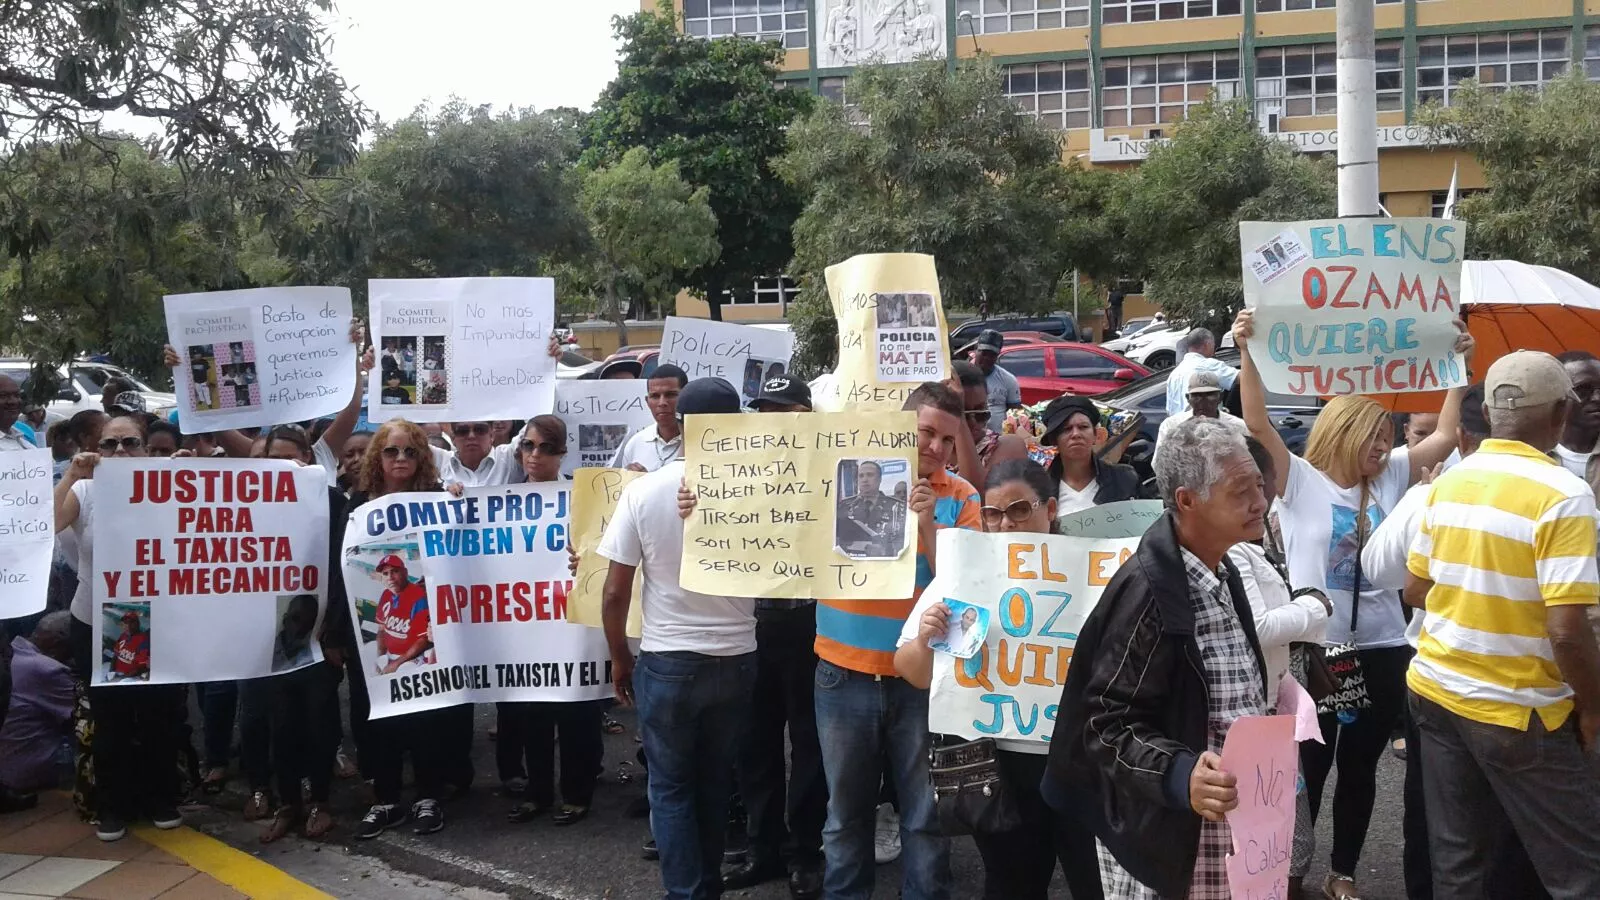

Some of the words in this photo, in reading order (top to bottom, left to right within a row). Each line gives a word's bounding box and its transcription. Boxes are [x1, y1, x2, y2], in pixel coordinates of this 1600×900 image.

[1310, 223, 1365, 259] EL
[1302, 265, 1454, 313] OZAMA
[196, 316, 232, 327] COMITE
[262, 304, 306, 325] Basta
[319, 301, 337, 319] de
[386, 316, 447, 326] PRO-JUSTICIA
[398, 308, 434, 317] COMITE
[466, 303, 486, 319] No
[502, 305, 534, 318] mas
[185, 323, 248, 336] PRO-JUSTICIA
[460, 322, 542, 346] Impunidad
[879, 332, 937, 342] POLICIA
[1267, 317, 1420, 364] QUIERE
[267, 348, 339, 370] queremos
[879, 351, 937, 365] MATE
[461, 367, 545, 387] #RubenDiaz
[880, 367, 893, 376] YO
[897, 367, 911, 376] ME
[913, 366, 938, 376] PARO
[701, 428, 806, 452] GENERAL
[815, 429, 860, 449] NEY
[700, 464, 718, 480] EL
[724, 460, 797, 478] TAXISTA
[129, 469, 298, 504] JUSTICIA
[765, 481, 812, 496] DIAZ
[821, 479, 833, 498] Y
[178, 507, 253, 533] PARA
[366, 496, 480, 537] COMITE
[487, 490, 571, 523] PRO-J
[770, 508, 818, 524] BAEZ
[1106, 511, 1122, 523] de
[136, 538, 166, 565] EL
[174, 536, 292, 564] TAXISTA
[423, 526, 513, 558] RUBEN
[520, 524, 538, 553] Y
[546, 523, 570, 552] C
[695, 537, 731, 550] SON
[742, 537, 791, 550] MAS
[1008, 542, 1067, 582] EL
[103, 571, 122, 598] Y
[130, 570, 160, 597] EL
[168, 565, 319, 596] MECANICO
[699, 559, 761, 573] SERIO
[773, 560, 815, 578] QUE
[830, 564, 868, 590] TU
[999, 587, 1078, 641] OZ
[495, 662, 560, 688] TAXISTA
[564, 662, 574, 687] Y
[579, 661, 600, 687] EL
